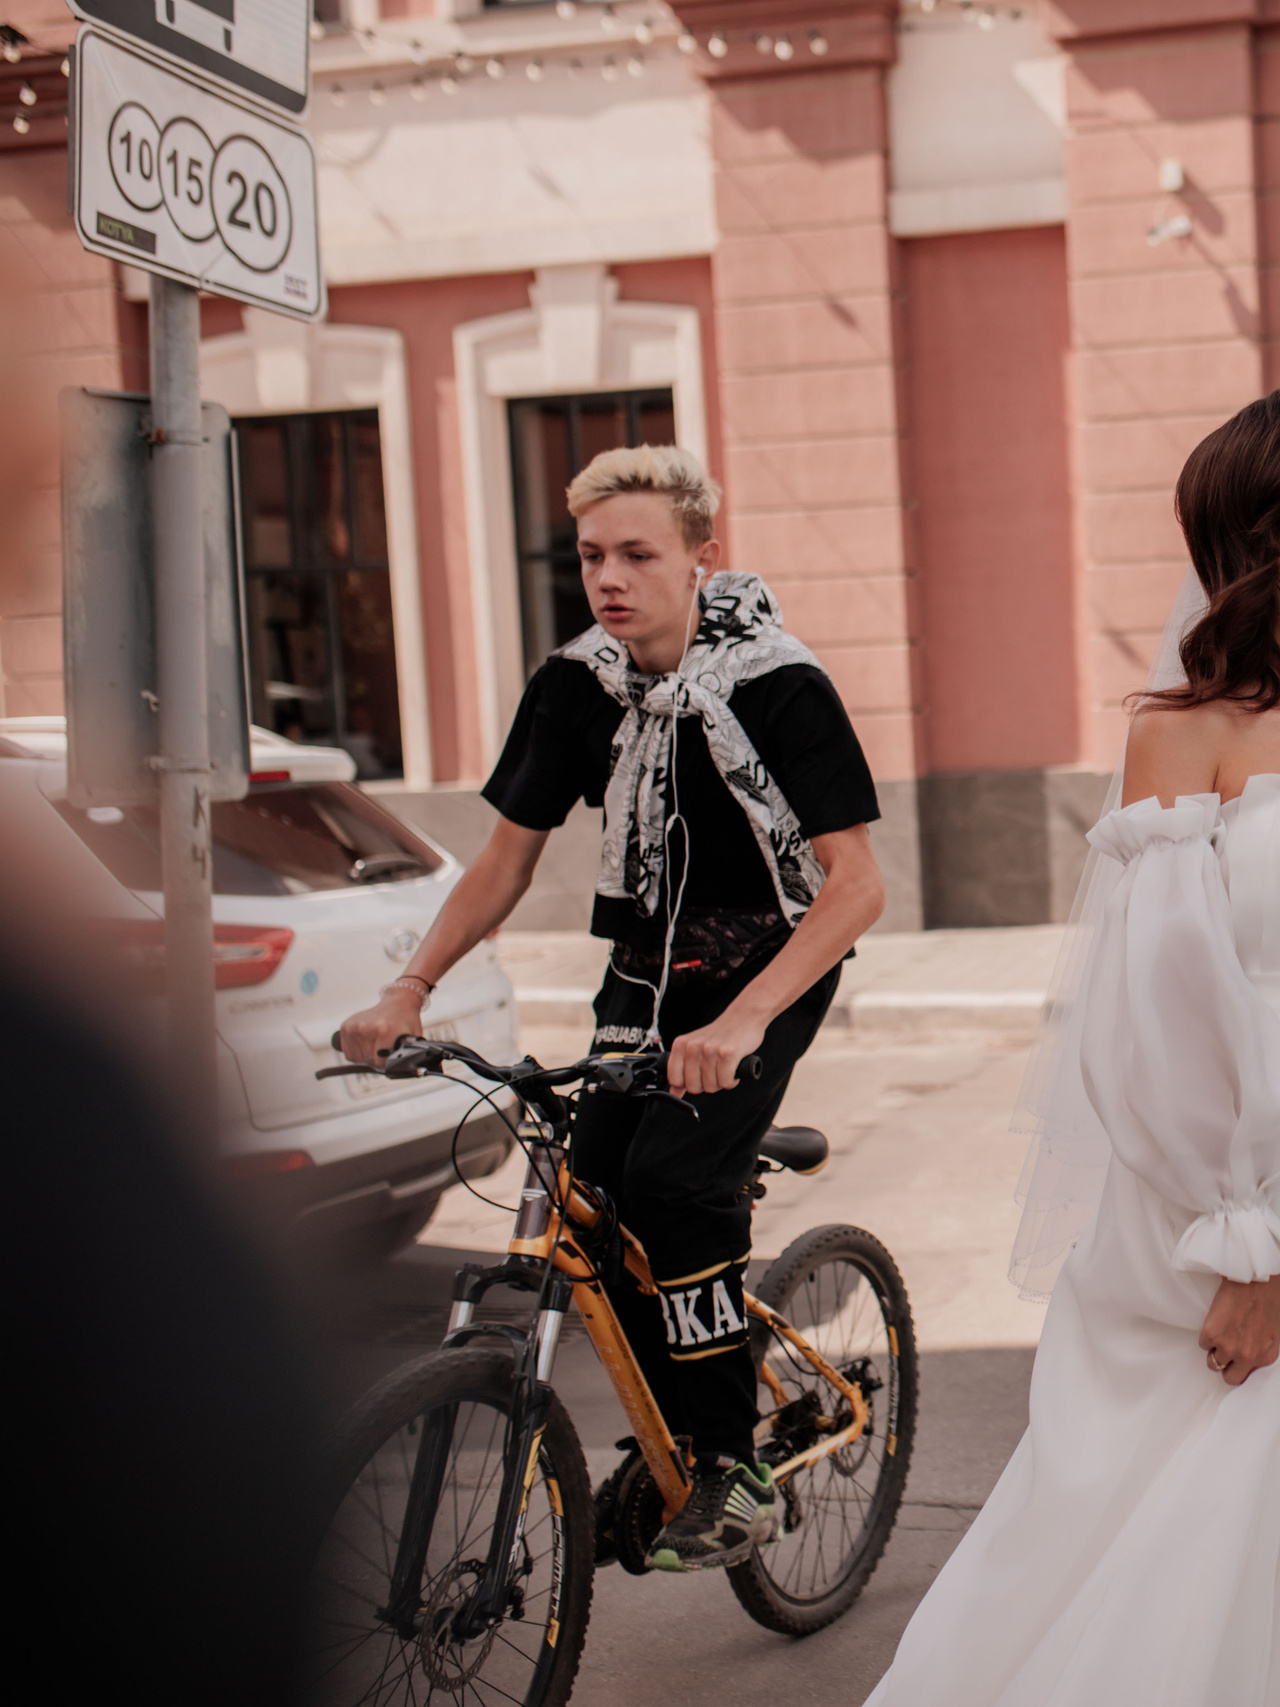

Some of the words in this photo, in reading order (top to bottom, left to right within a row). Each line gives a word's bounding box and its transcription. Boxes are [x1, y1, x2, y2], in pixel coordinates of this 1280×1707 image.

[119, 130, 154, 182] 10
[166, 149, 204, 206] 15
[226, 171, 277, 238] 20
